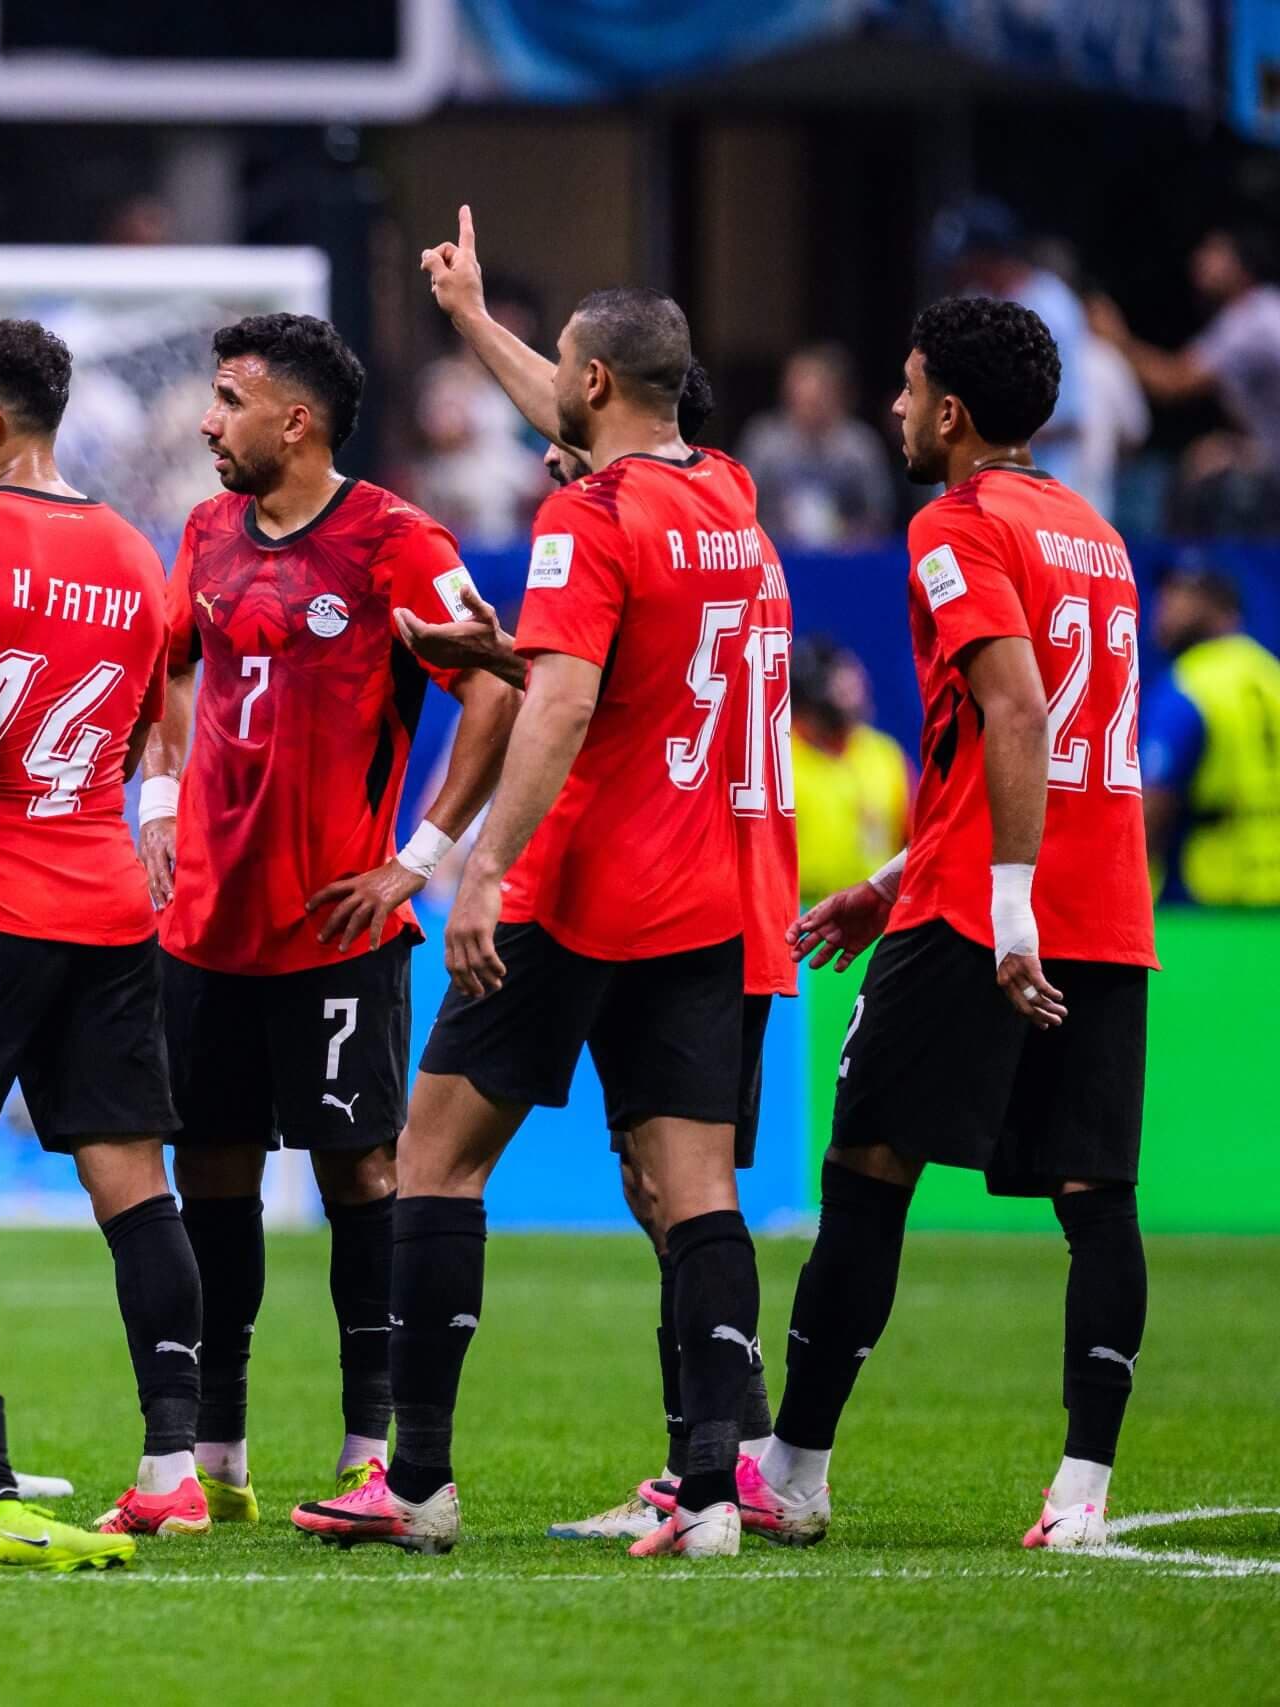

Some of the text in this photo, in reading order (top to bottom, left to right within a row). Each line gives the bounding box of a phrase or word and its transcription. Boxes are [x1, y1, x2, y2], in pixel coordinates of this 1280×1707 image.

[666, 529, 692, 570] R.
[1035, 529, 1136, 585] MARMOUS
[12, 568, 142, 631] H. FATHY
[238, 656, 273, 740] 7
[666, 600, 748, 790] 5
[730, 626, 797, 818] 12
[1048, 595, 1143, 799] 22
[323, 998, 360, 1080] 7
